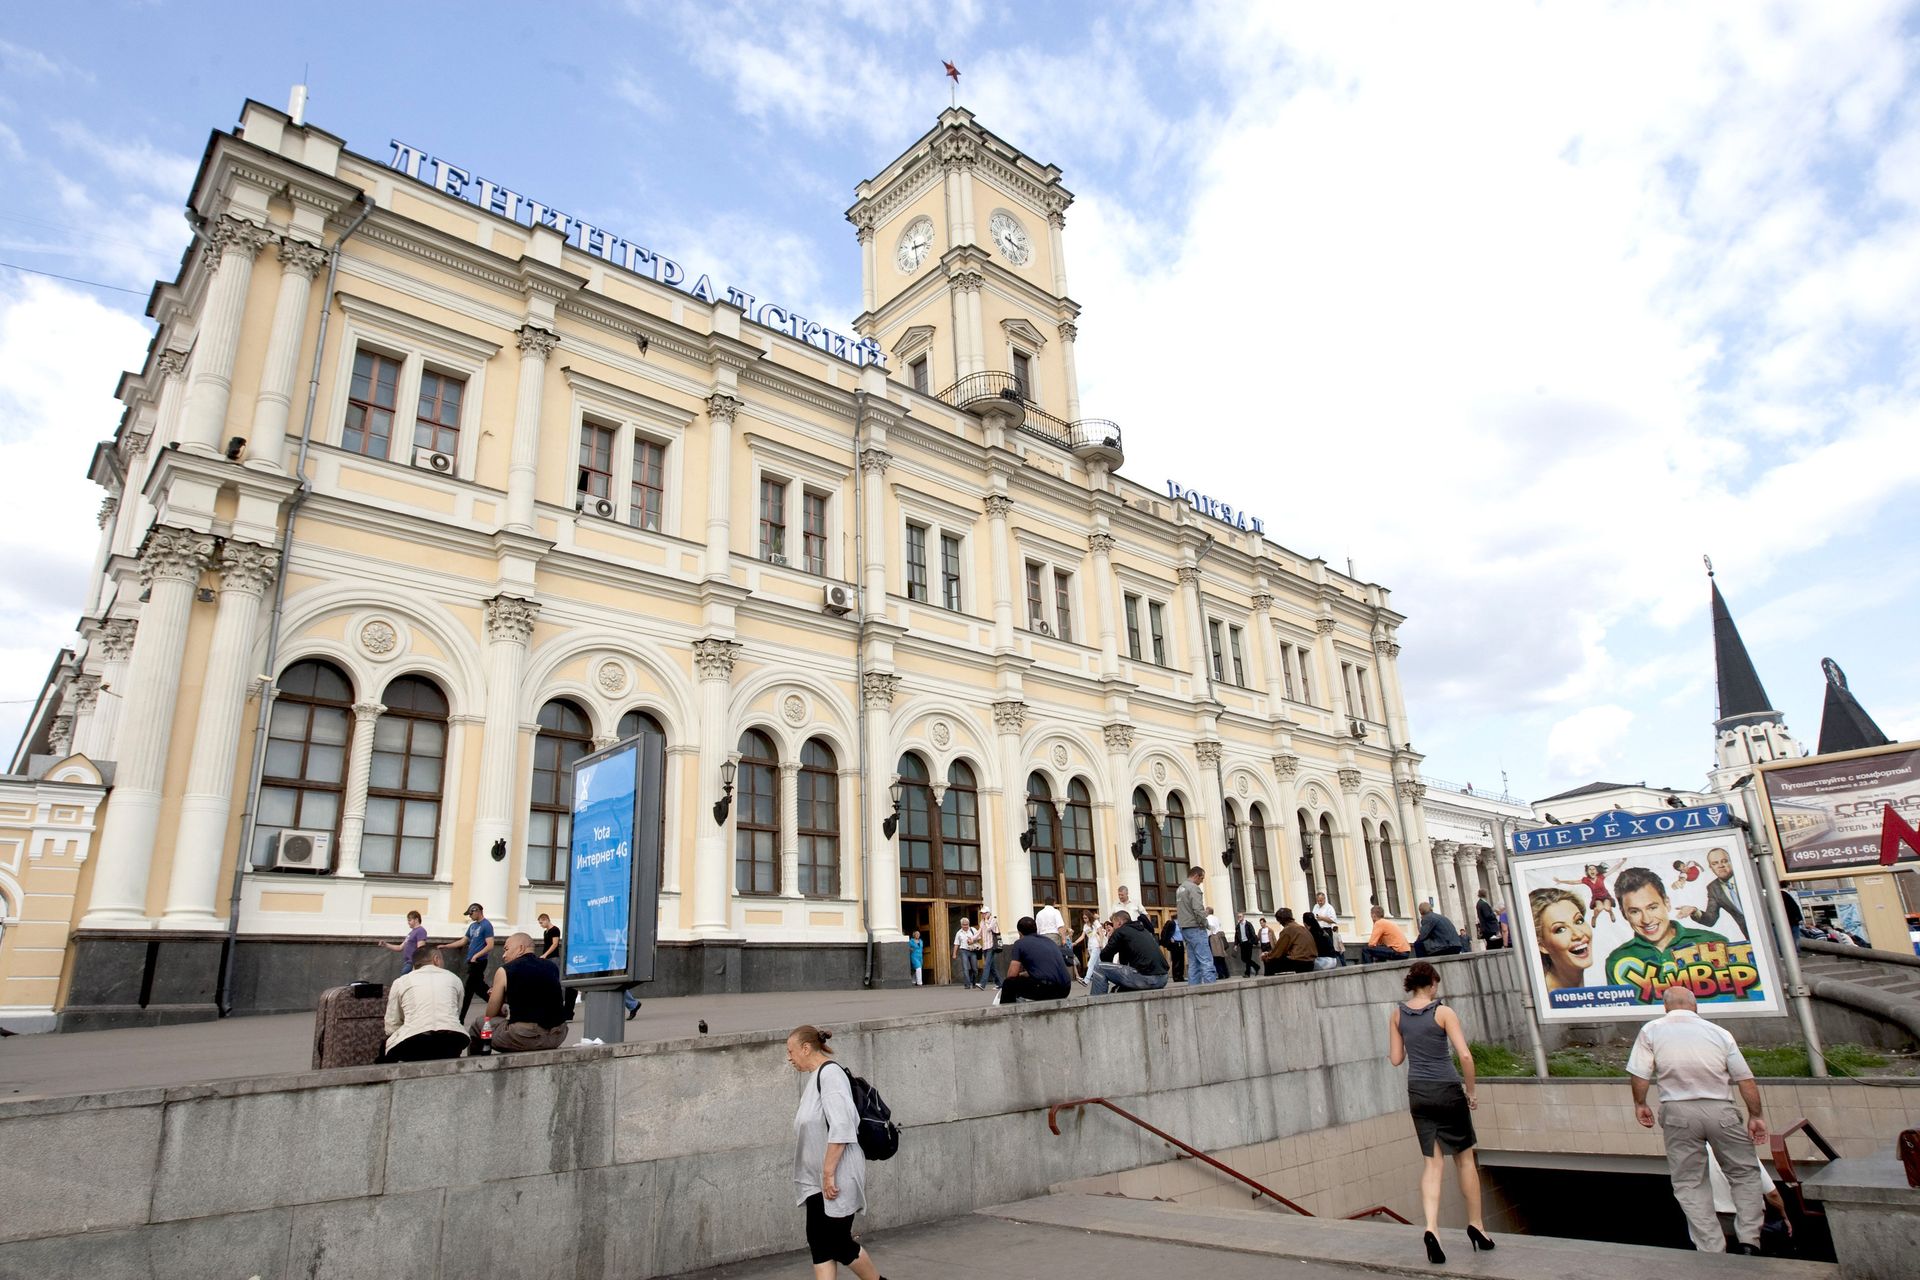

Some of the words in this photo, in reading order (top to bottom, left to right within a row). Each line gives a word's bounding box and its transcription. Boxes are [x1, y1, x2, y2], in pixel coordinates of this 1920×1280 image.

[390, 139, 887, 368] ЛЕНИНГРАДСКИЙ
[594, 825, 610, 841] Yota
[1537, 813, 1701, 847] ПЕРЕХОД
[1837, 824, 1868, 833] ОТЕЛЬ
[577, 848, 615, 870] Интернет
[616, 841, 628, 858] 4G
[1793, 850, 1820, 862] (495)
[1671, 941, 1753, 969] ТНТ
[1555, 992, 1594, 1002] новые
[1597, 989, 1635, 1001] серии
